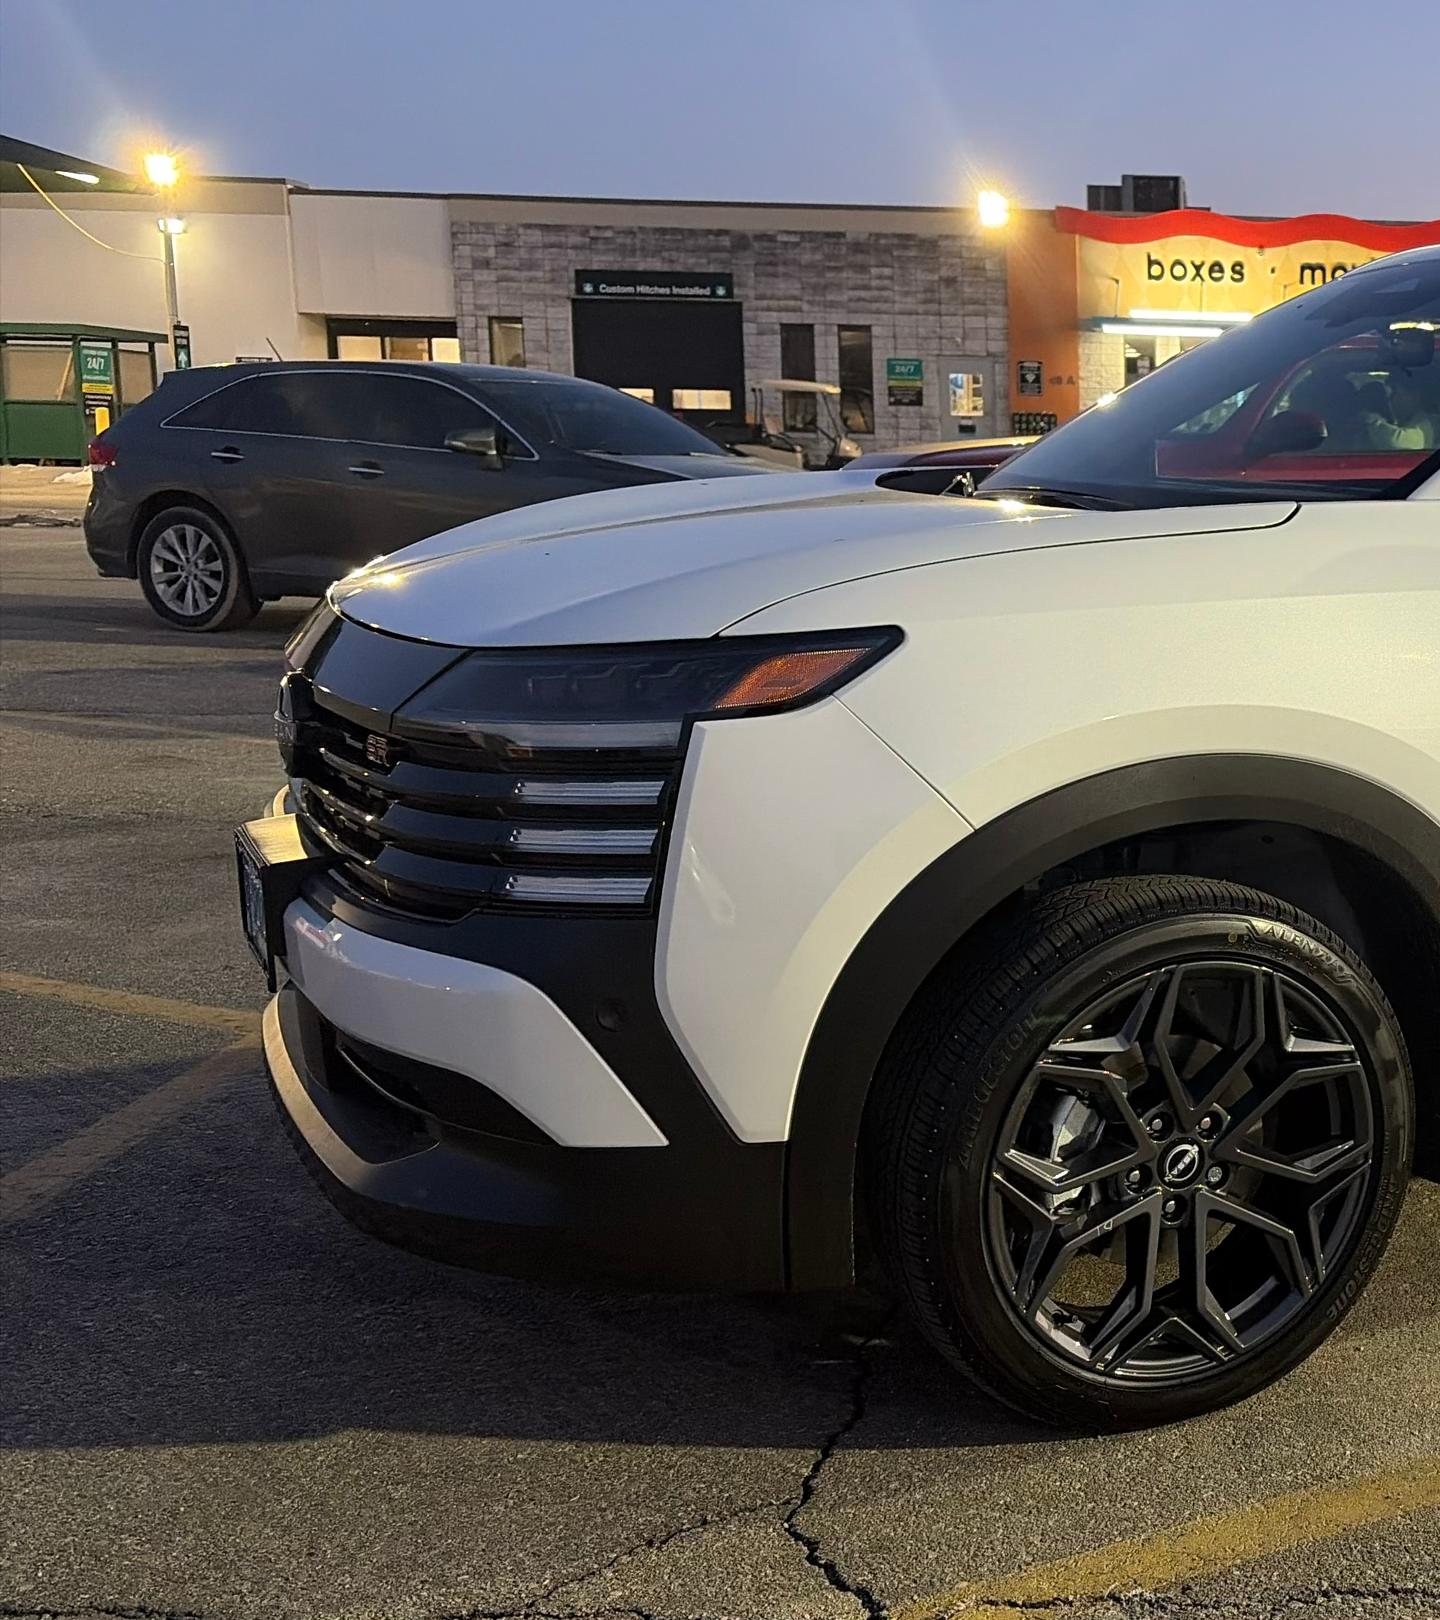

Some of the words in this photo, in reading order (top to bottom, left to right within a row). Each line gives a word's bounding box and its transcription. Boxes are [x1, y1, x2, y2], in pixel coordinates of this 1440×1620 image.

[1147, 252, 1244, 282] boxes
[1299, 262, 1356, 285] mo
[599, 284, 635, 293] Custom
[636, 285, 670, 294] Hitches
[672, 286, 711, 295] Installed
[87, 357, 104, 369] 24/7
[895, 365, 915, 373] 24/7
[1164, 1144, 1200, 1183] NISSAN
